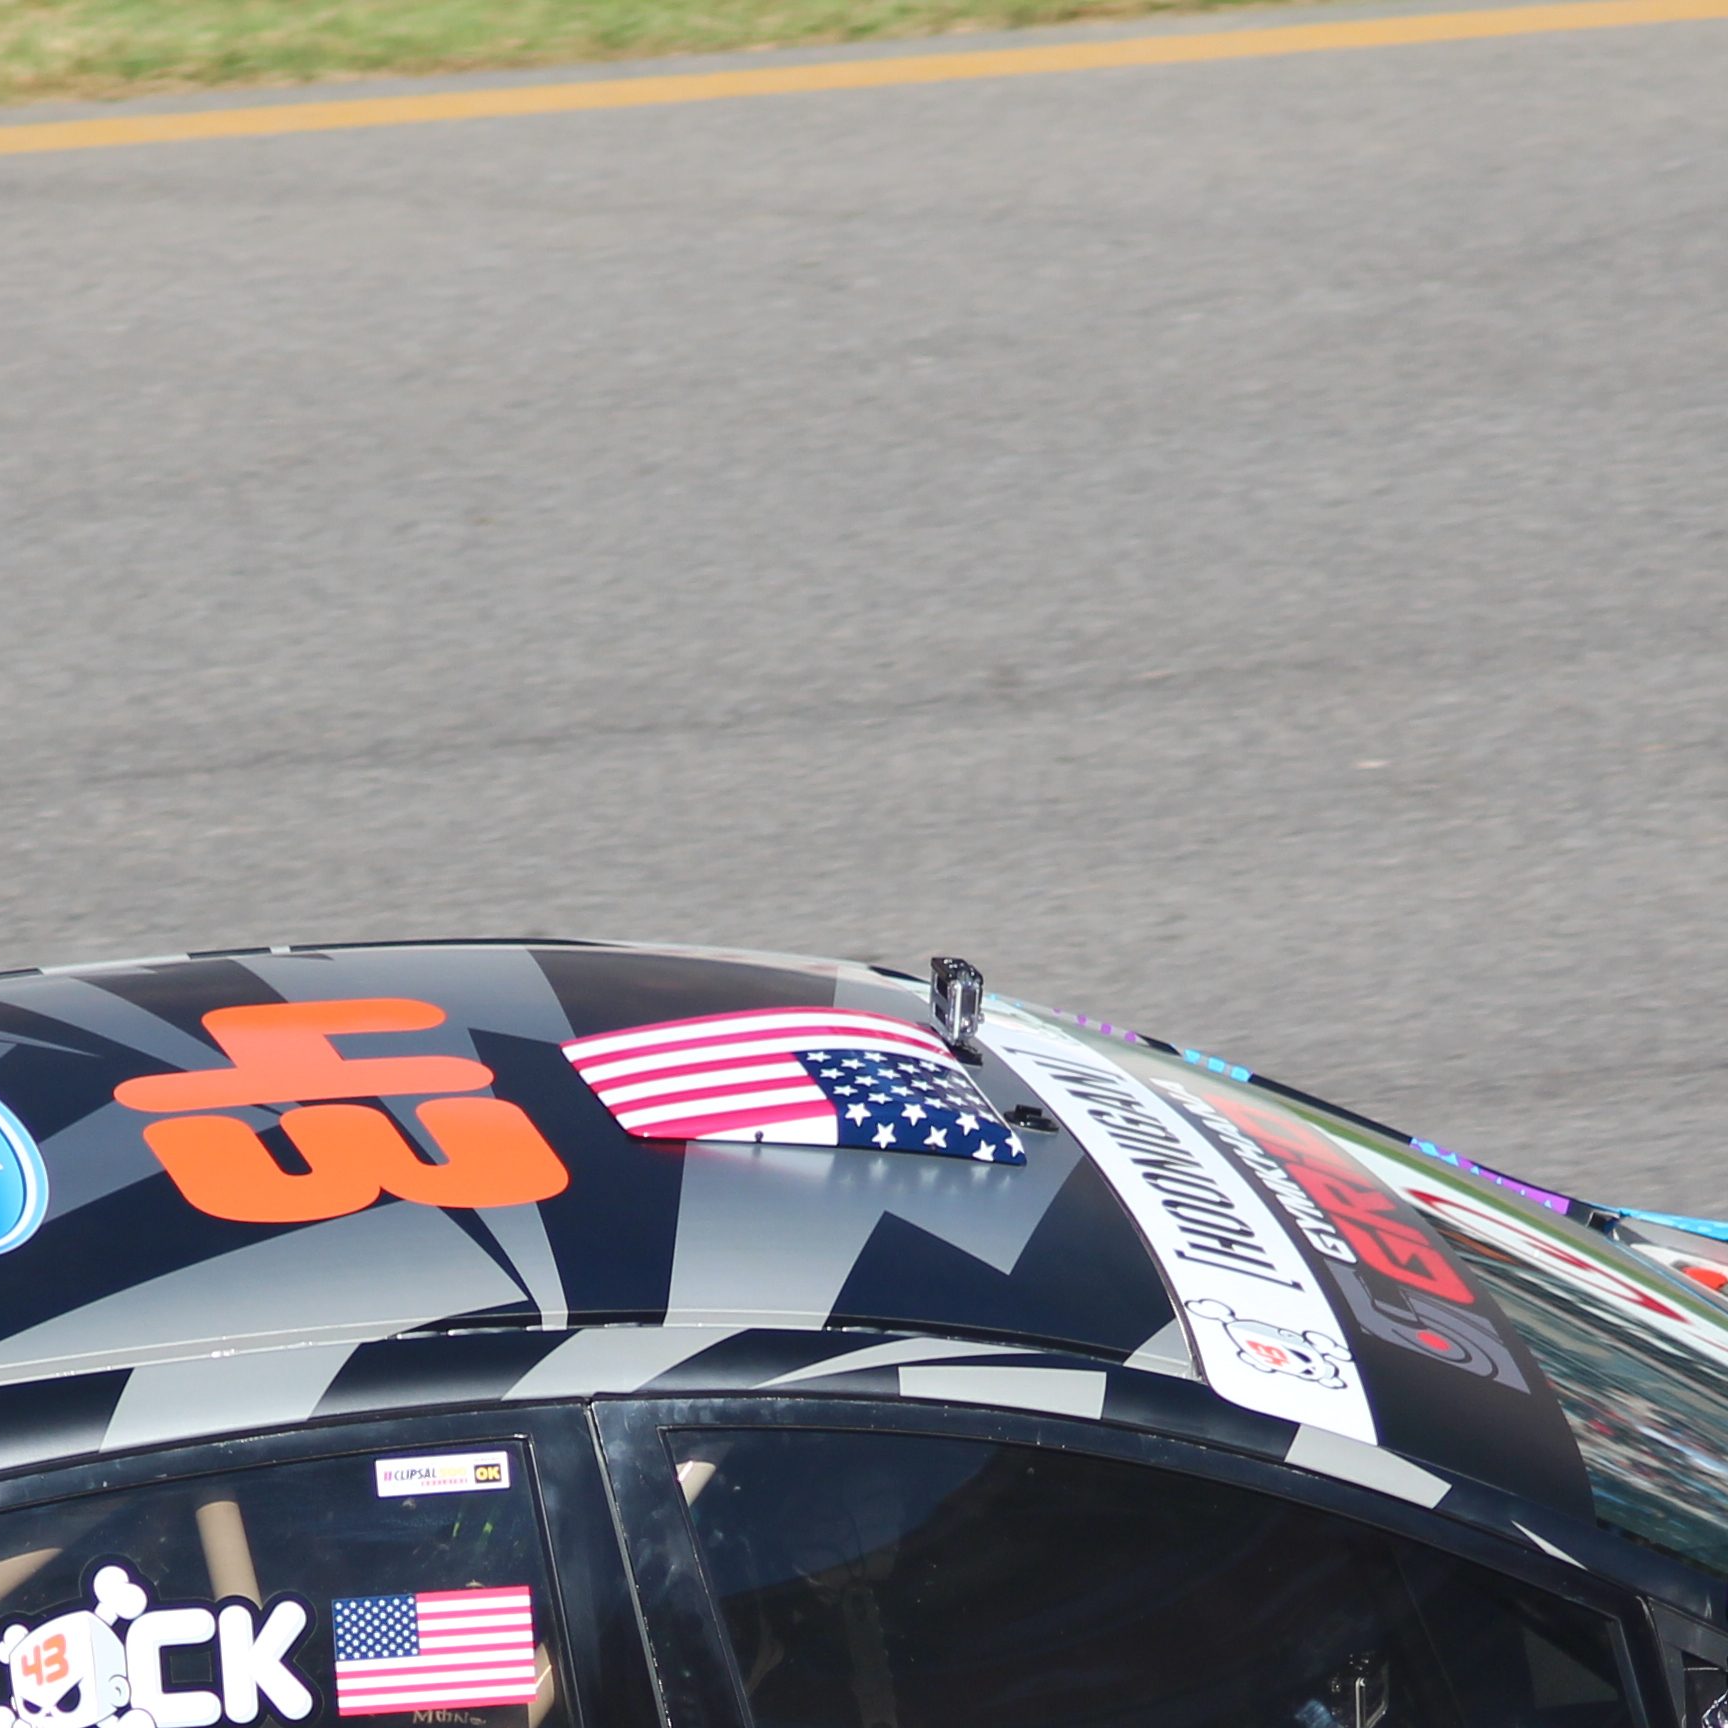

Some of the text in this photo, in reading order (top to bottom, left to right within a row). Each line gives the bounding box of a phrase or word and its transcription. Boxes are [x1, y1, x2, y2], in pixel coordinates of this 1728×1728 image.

[113, 998, 570, 1224] 43
[393, 1468, 438, 1482] CLIPSAL
[474, 1465, 502, 1482] OK
[20, 1632, 70, 1687] 43
